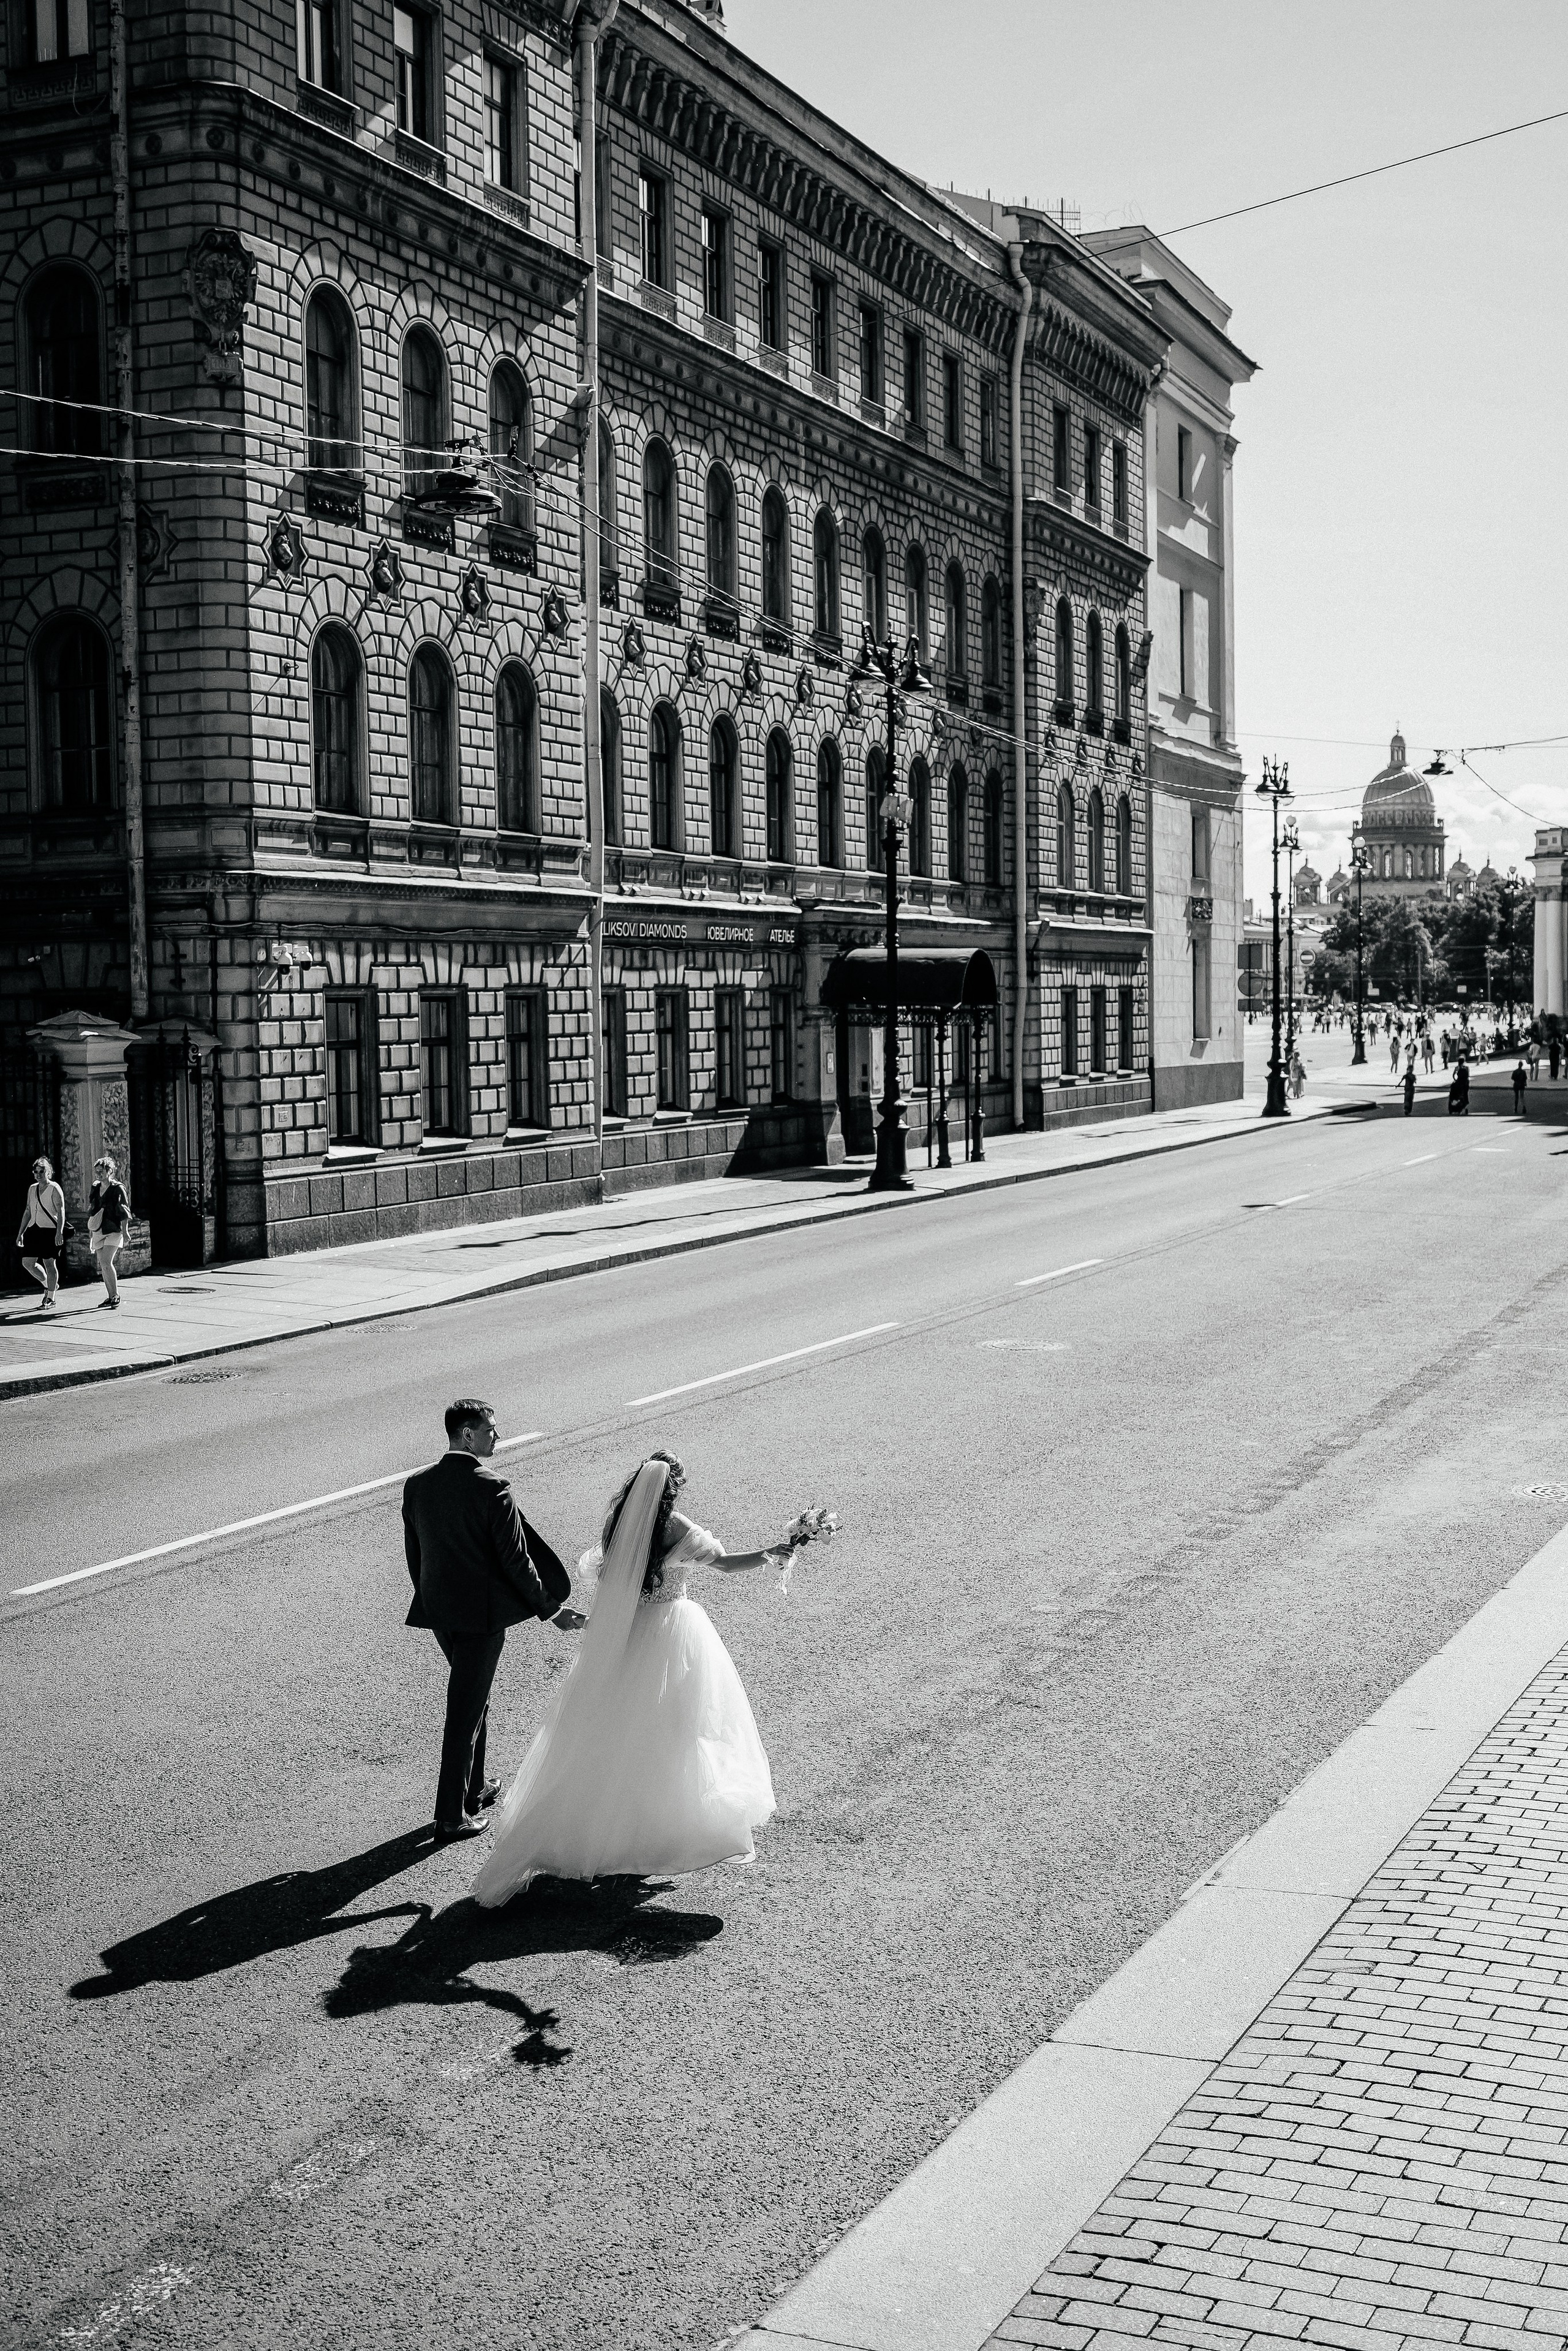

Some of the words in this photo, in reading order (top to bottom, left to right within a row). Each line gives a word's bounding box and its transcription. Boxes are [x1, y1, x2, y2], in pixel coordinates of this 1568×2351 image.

[602, 921, 636, 937] LIKSOV
[639, 923, 687, 938] DIAMONDS
[707, 926, 754, 942] ЮВЕЛИРНОЕ
[769, 929, 795, 943] АТЕЛЬЕ
